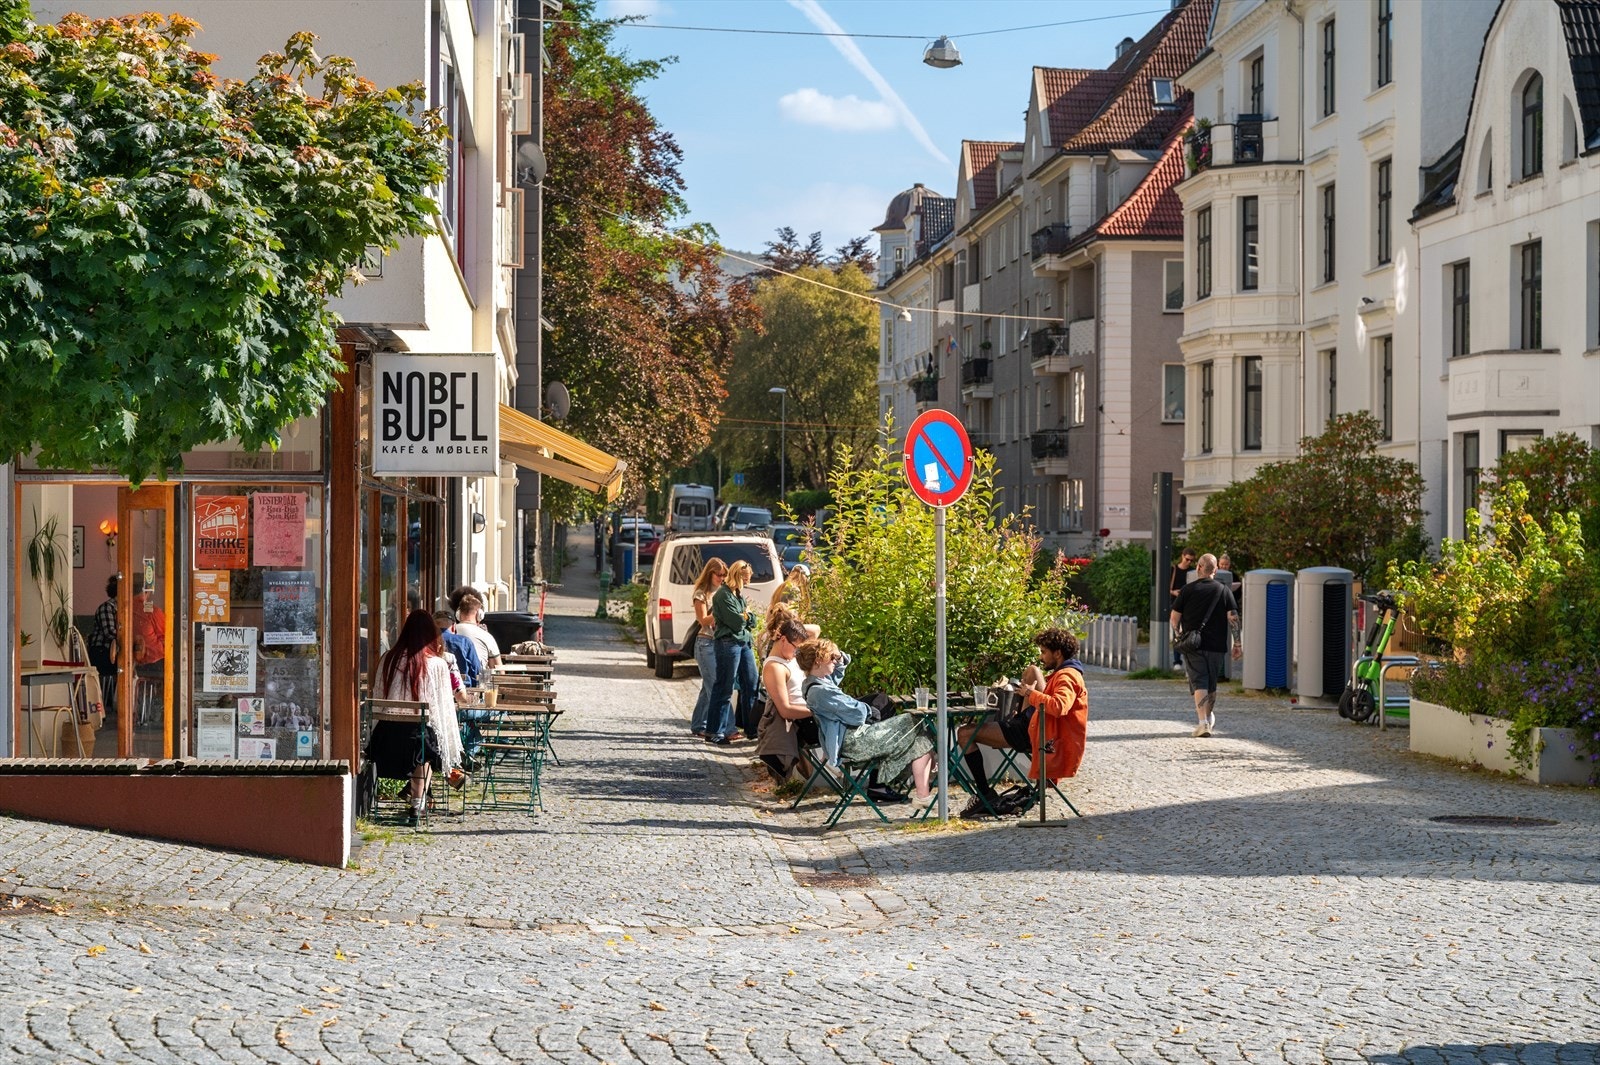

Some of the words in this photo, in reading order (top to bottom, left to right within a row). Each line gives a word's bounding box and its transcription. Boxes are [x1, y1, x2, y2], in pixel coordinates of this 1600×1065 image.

[382, 444, 414, 454] KAFÉ
[421, 446, 429, 454] &
[436, 445, 488, 454] MØBLER
[198, 538, 245, 549] TRIKKE
